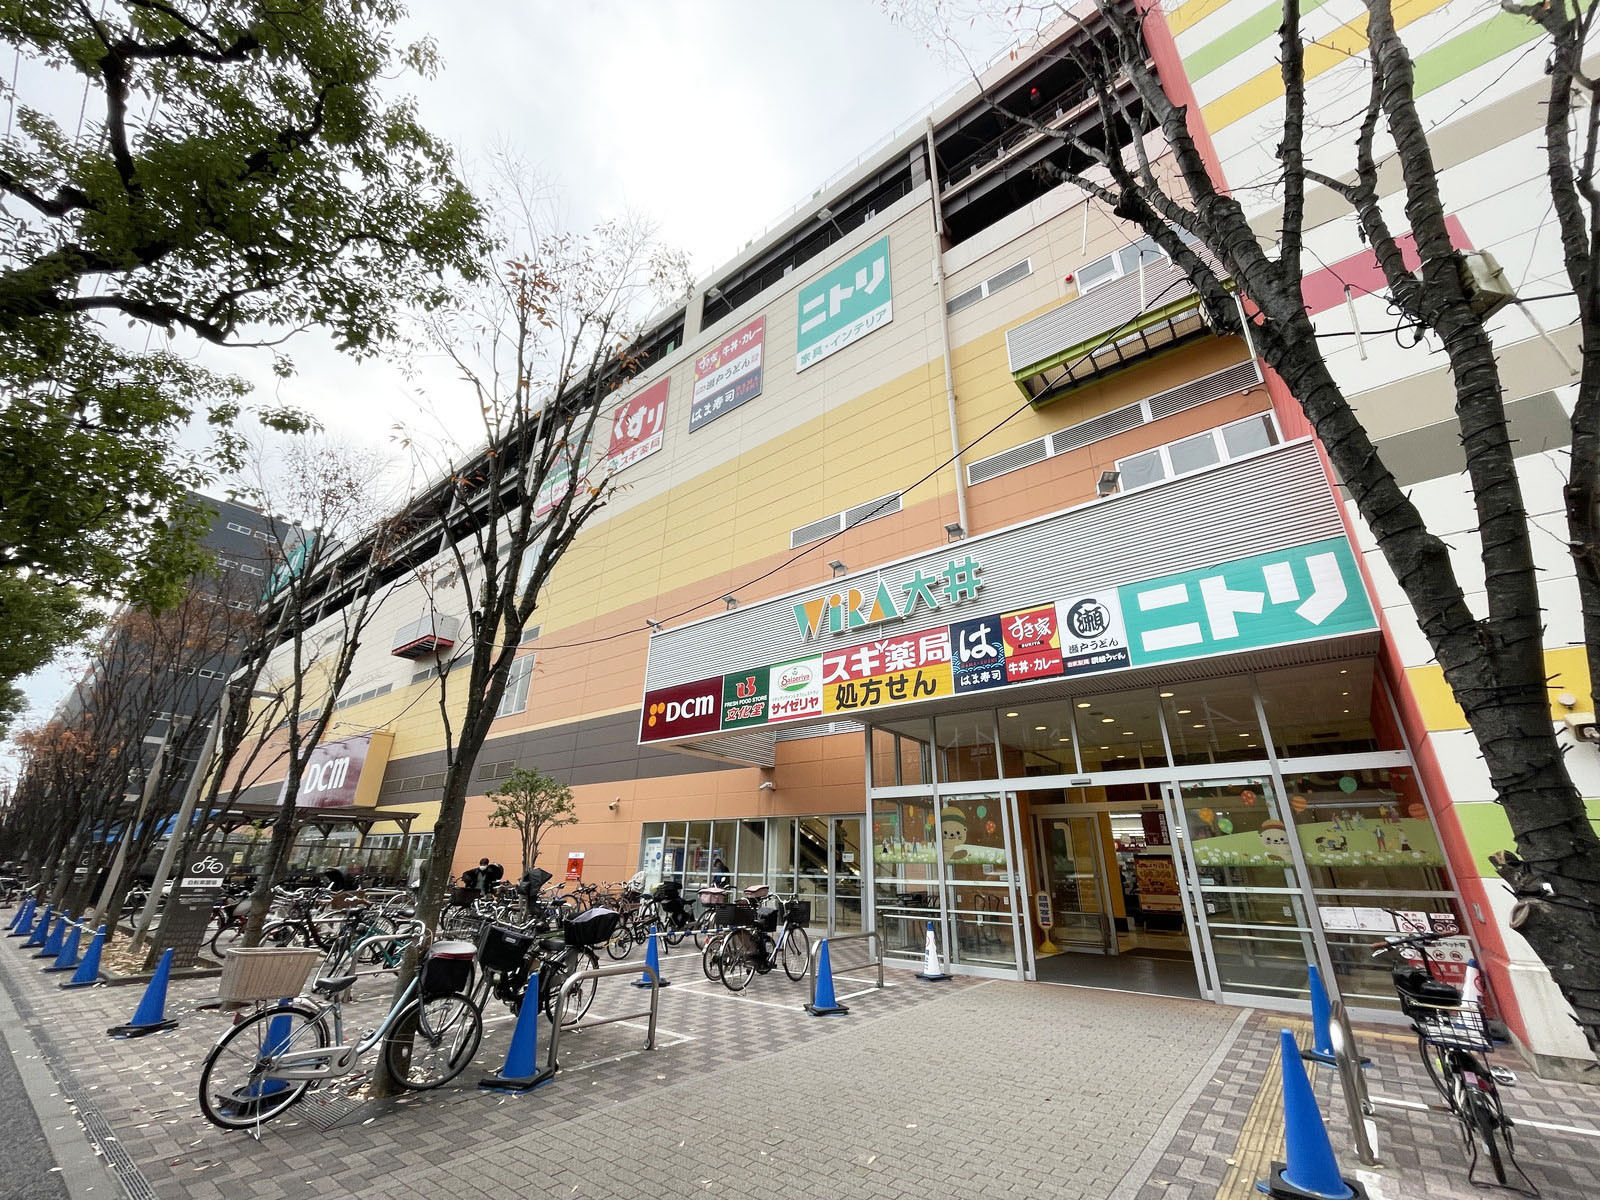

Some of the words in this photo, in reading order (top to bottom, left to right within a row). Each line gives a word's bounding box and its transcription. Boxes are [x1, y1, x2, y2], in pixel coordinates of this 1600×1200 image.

[801, 256, 885, 334] ニトリ
[722, 327, 763, 356] 牛丼・カレー
[800, 308, 887, 366] 家具・インテリア
[614, 401, 664, 440] くすり
[691, 389, 735, 424] はま寿司
[619, 437, 660, 467] スギ薬局
[901, 555, 985, 616] 大井
[1137, 551, 1348, 652] ニトリ
[960, 623, 998, 662] は
[1008, 615, 1052, 641] すき家
[1069, 637, 1119, 655] 瀬戸うどん
[823, 633, 950, 684] スギ薬局
[1008, 658, 1061, 675] 牛丼・カレー
[835, 670, 937, 711] 処方せん
[960, 670, 1001, 686] はま寿司
[666, 694, 714, 722] DCM
[771, 697, 819, 715] サイゼリヤ
[303, 756, 350, 794] DCM
